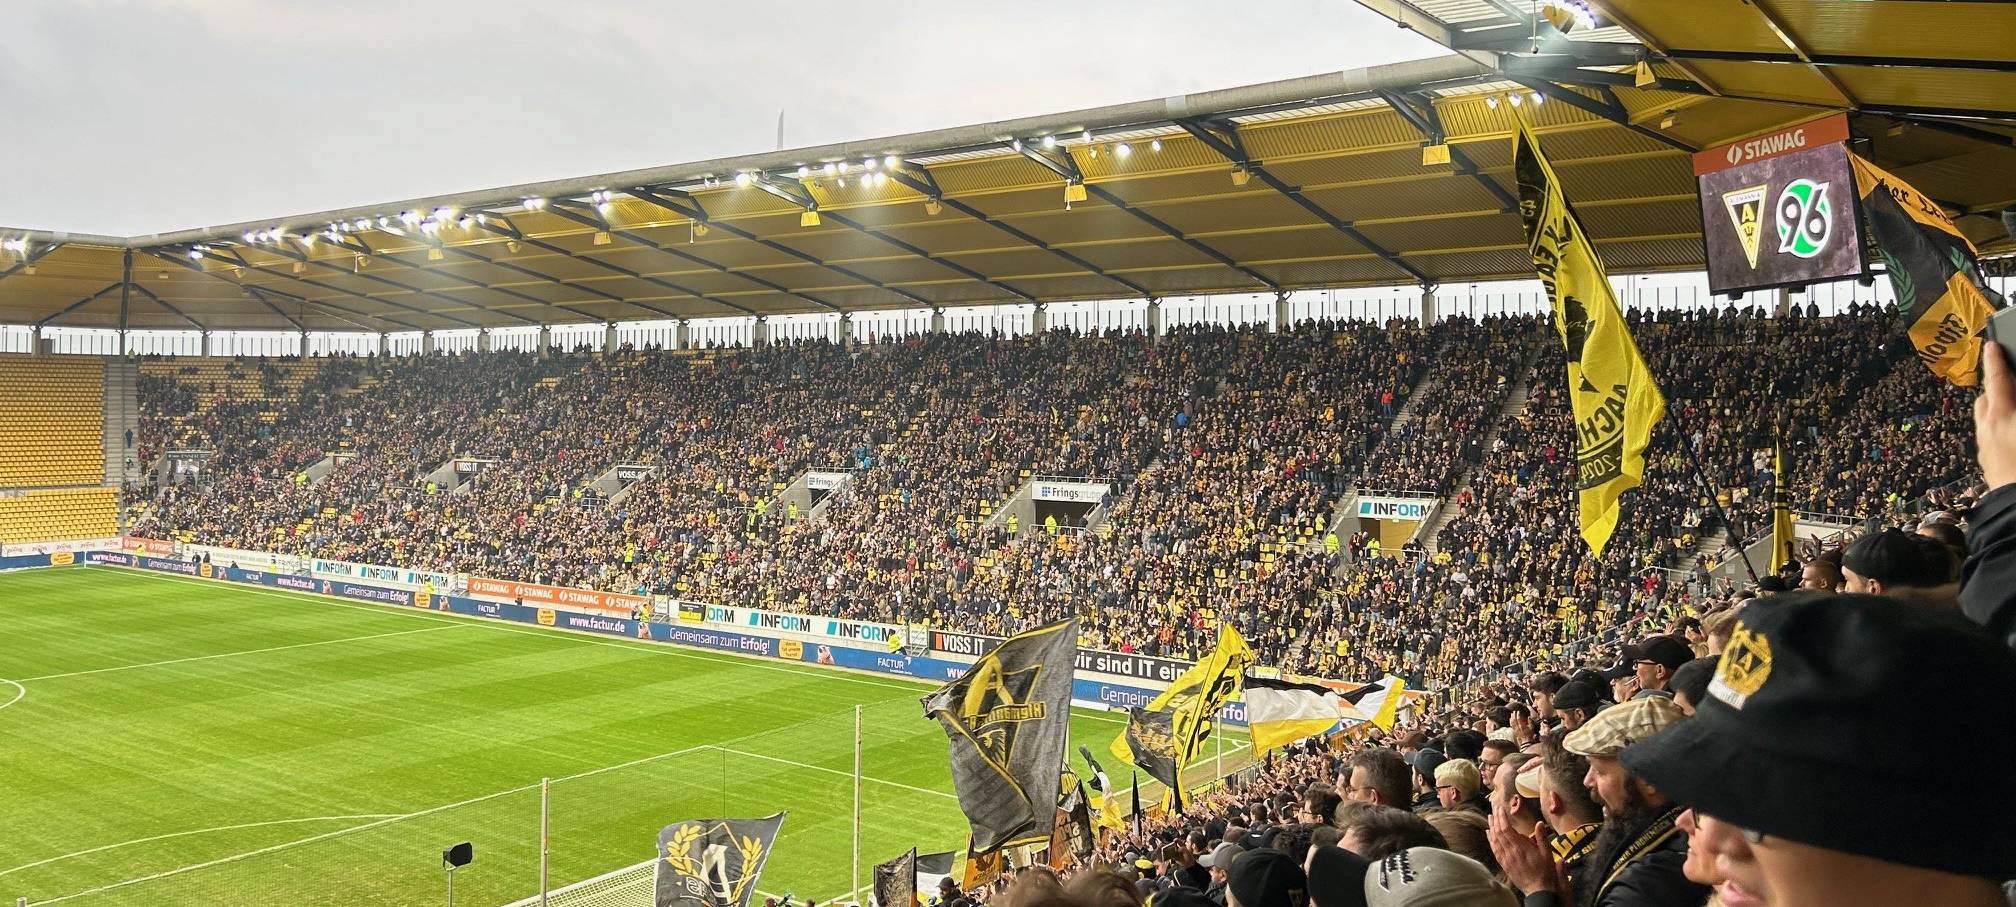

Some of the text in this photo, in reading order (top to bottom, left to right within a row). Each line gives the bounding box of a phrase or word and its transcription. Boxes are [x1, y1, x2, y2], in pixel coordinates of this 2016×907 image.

[1744, 129, 1805, 160] STAWAG
[1780, 181, 1830, 250] 96
[1374, 503, 1430, 517] INFORM
[322, 562, 352, 575] INFORM
[368, 568, 398, 582] INFORM
[278, 577, 314, 590] www.factur.de
[415, 574, 448, 588] INFORM
[344, 585, 376, 599] Gemeinsam
[377, 590, 390, 600] zum
[390, 591, 409, 605] Erfolg!
[480, 583, 509, 594] STAWAG
[524, 588, 553, 600] STAWAG
[568, 592, 599, 604] STAWAG
[616, 598, 641, 608] STAW
[478, 604, 495, 613] FACTUR
[708, 607, 734, 623] ORM
[570, 617, 626, 632] www.factur.de
[761, 613, 811, 632] INFORM
[670, 627, 718, 645] Gemeinsam
[720, 637, 738, 648] zum
[740, 638, 770, 654] Erfolg!
[943, 634, 971, 654] VOSS
[974, 638, 984, 654] IT
[878, 657, 904, 670] FACTUR
[1096, 655, 1132, 674] sind
[1138, 659, 1154, 677] IT
[1159, 664, 1187, 680] ein
[1221, 708, 1248, 722] rfol
